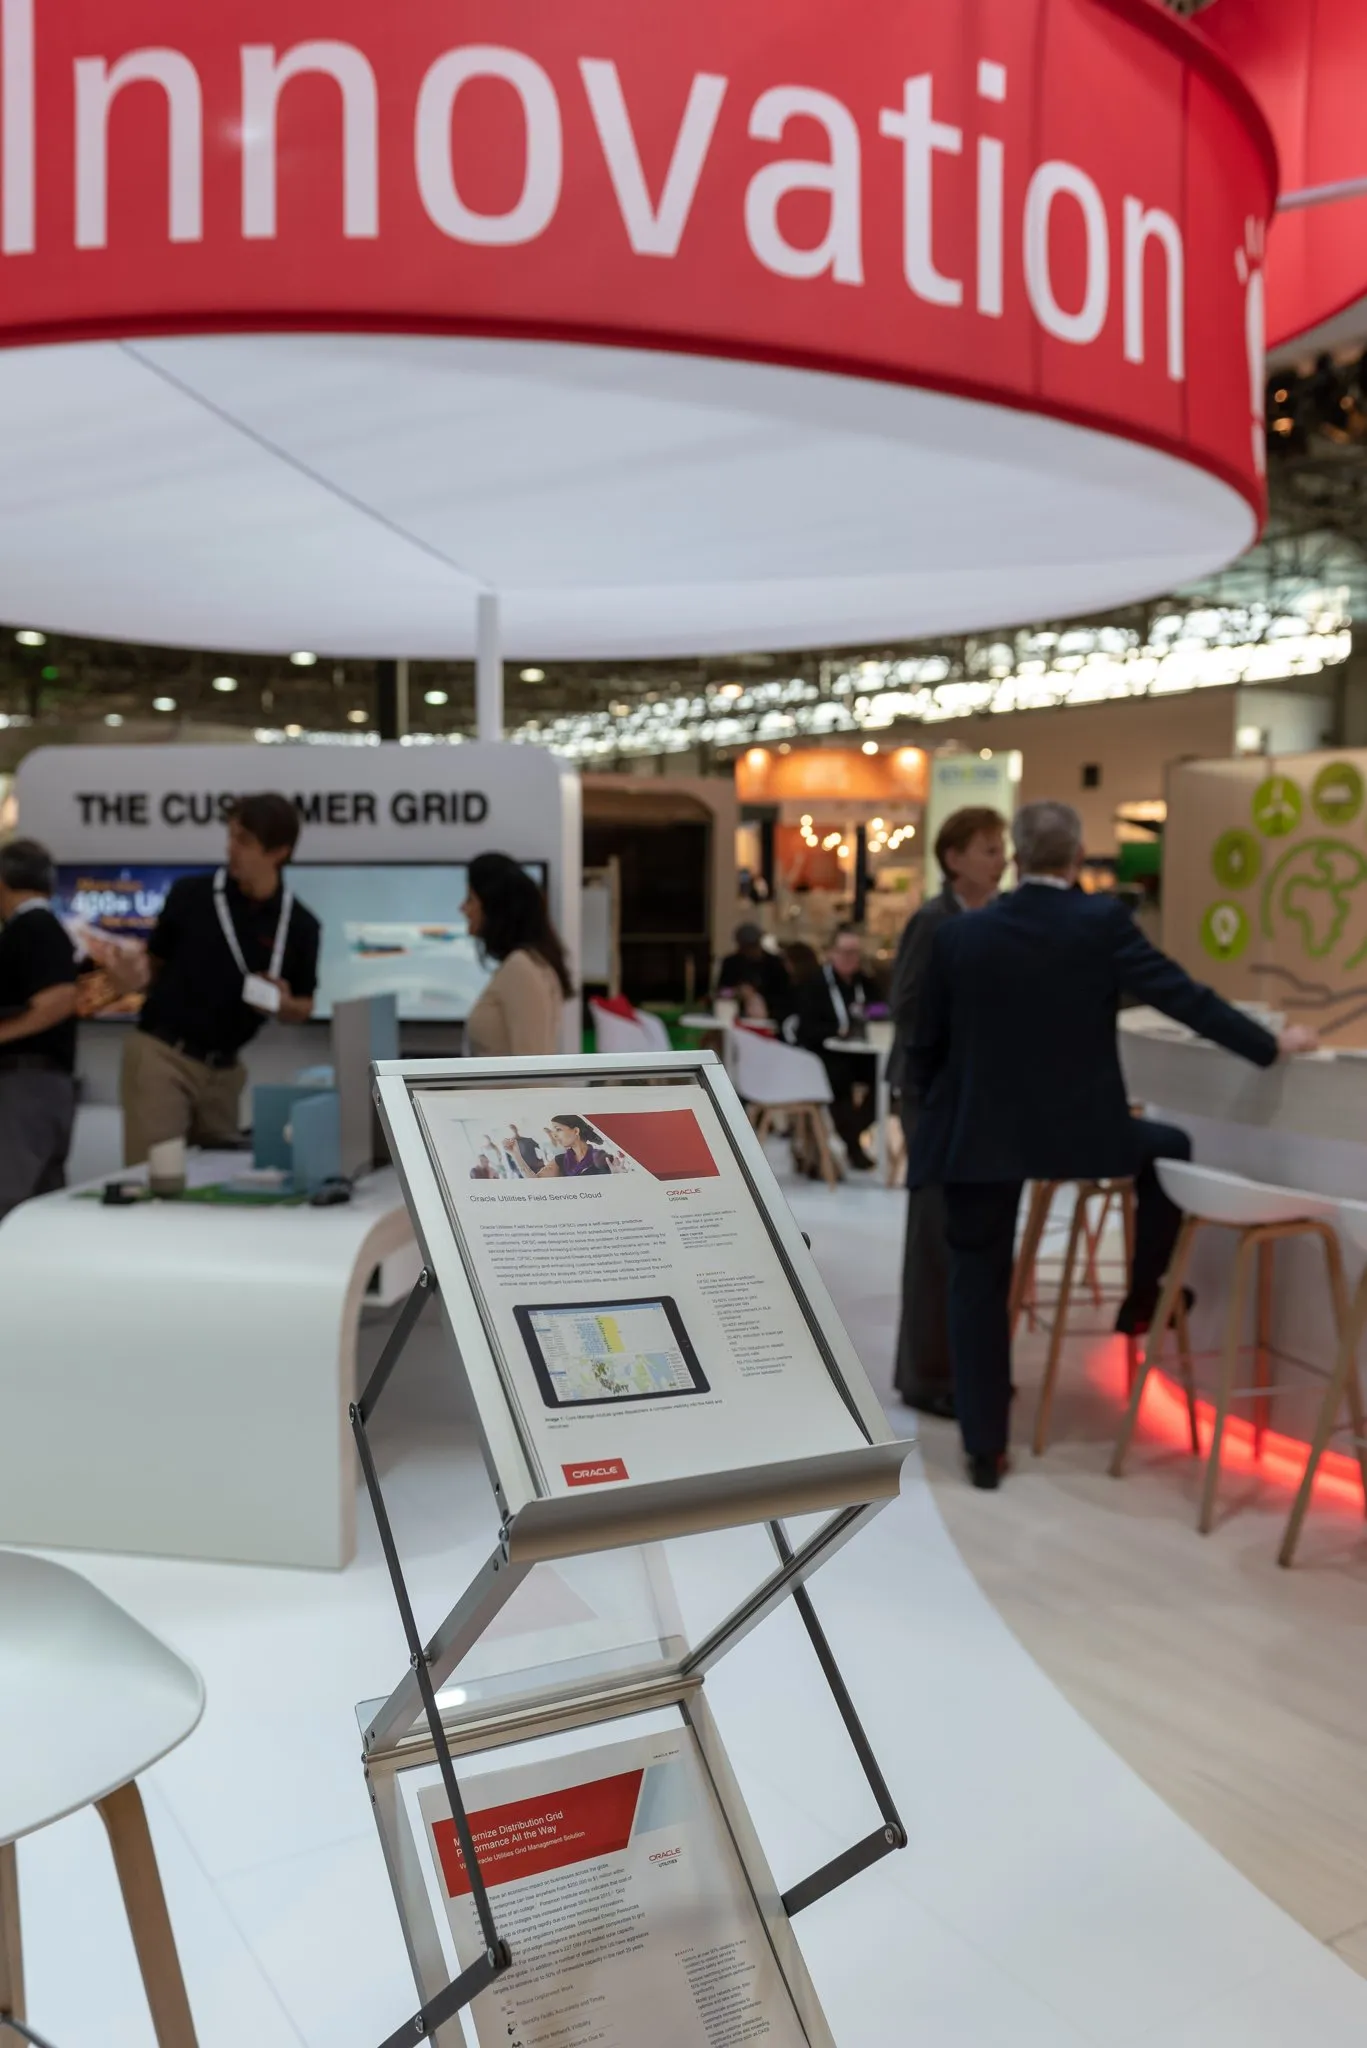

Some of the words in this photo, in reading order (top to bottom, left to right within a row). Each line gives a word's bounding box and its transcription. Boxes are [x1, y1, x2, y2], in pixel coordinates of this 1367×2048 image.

[3, 0, 1185, 381] Innovation
[76, 792, 149, 825] THE
[161, 792, 377, 825] CUSMER
[390, 792, 489, 825] GRID
[498, 1194, 527, 1202] Utilities
[528, 1194, 548, 1202] Field
[549, 1192, 577, 1201] Service
[579, 1191, 603, 1199] Cloud
[666, 1188, 702, 1197] ORACLE
[572, 1466, 618, 1479] ORACLE
[453, 1828, 498, 1848] Mernize
[499, 1817, 545, 1835] Distribution
[545, 1810, 564, 1823] Grid
[456, 1837, 511, 1859] Pormance
[511, 1831, 523, 1845] All
[524, 1828, 537, 1842] the
[538, 1825, 558, 1840] Way
[478, 1854, 493, 1866] racle
[493, 1849, 514, 1862] Utilities
[515, 1845, 528, 1856] Grid
[528, 1836, 564, 1853] Management
[564, 1830, 586, 1844] Solution
[649, 1847, 682, 1862] ORACLE
[658, 1859, 678, 1868] UTILITIES
